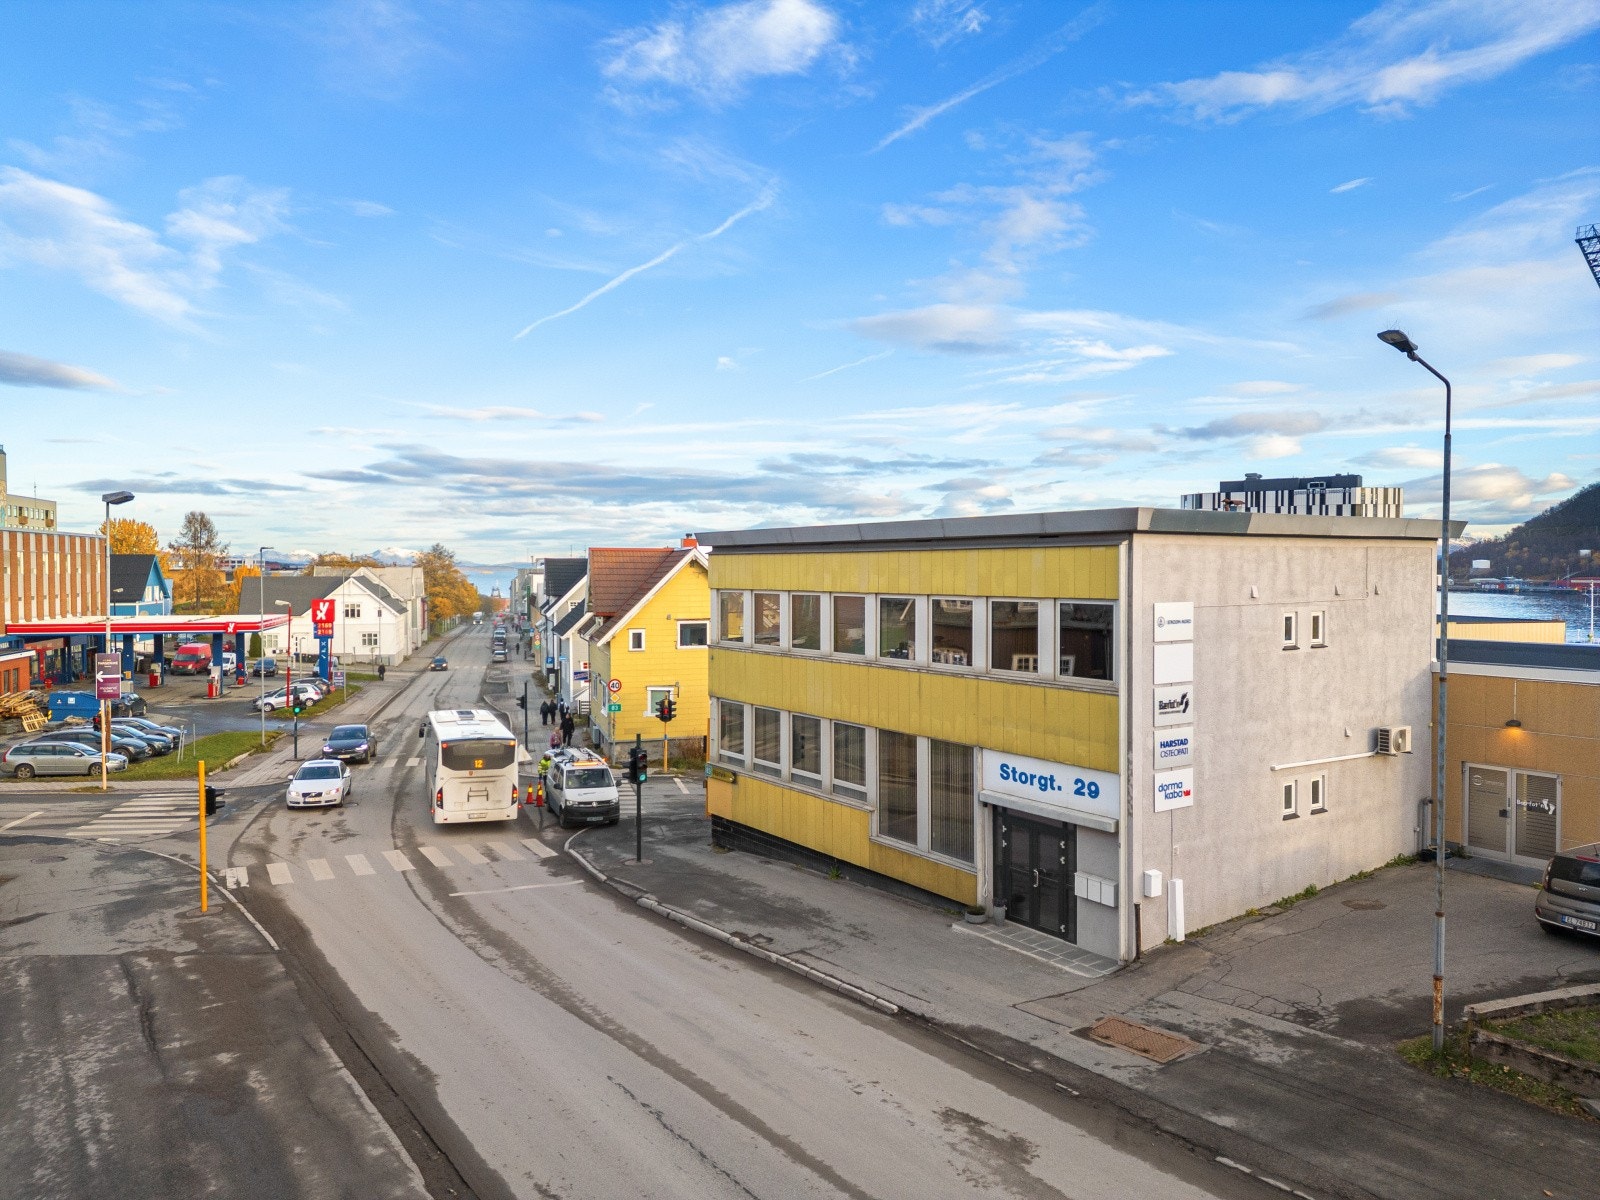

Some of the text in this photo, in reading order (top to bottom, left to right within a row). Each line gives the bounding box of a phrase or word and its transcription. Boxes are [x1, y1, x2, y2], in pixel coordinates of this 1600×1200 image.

[1160, 738, 1189, 749] HARSTAD
[1160, 747, 1189, 759] OSTEOPATI
[474, 760, 484, 769] 12
[999, 763, 1100, 799] Storgt. 29
[1158, 781, 1183, 793] dorma
[1164, 790, 1183, 800] kaba
